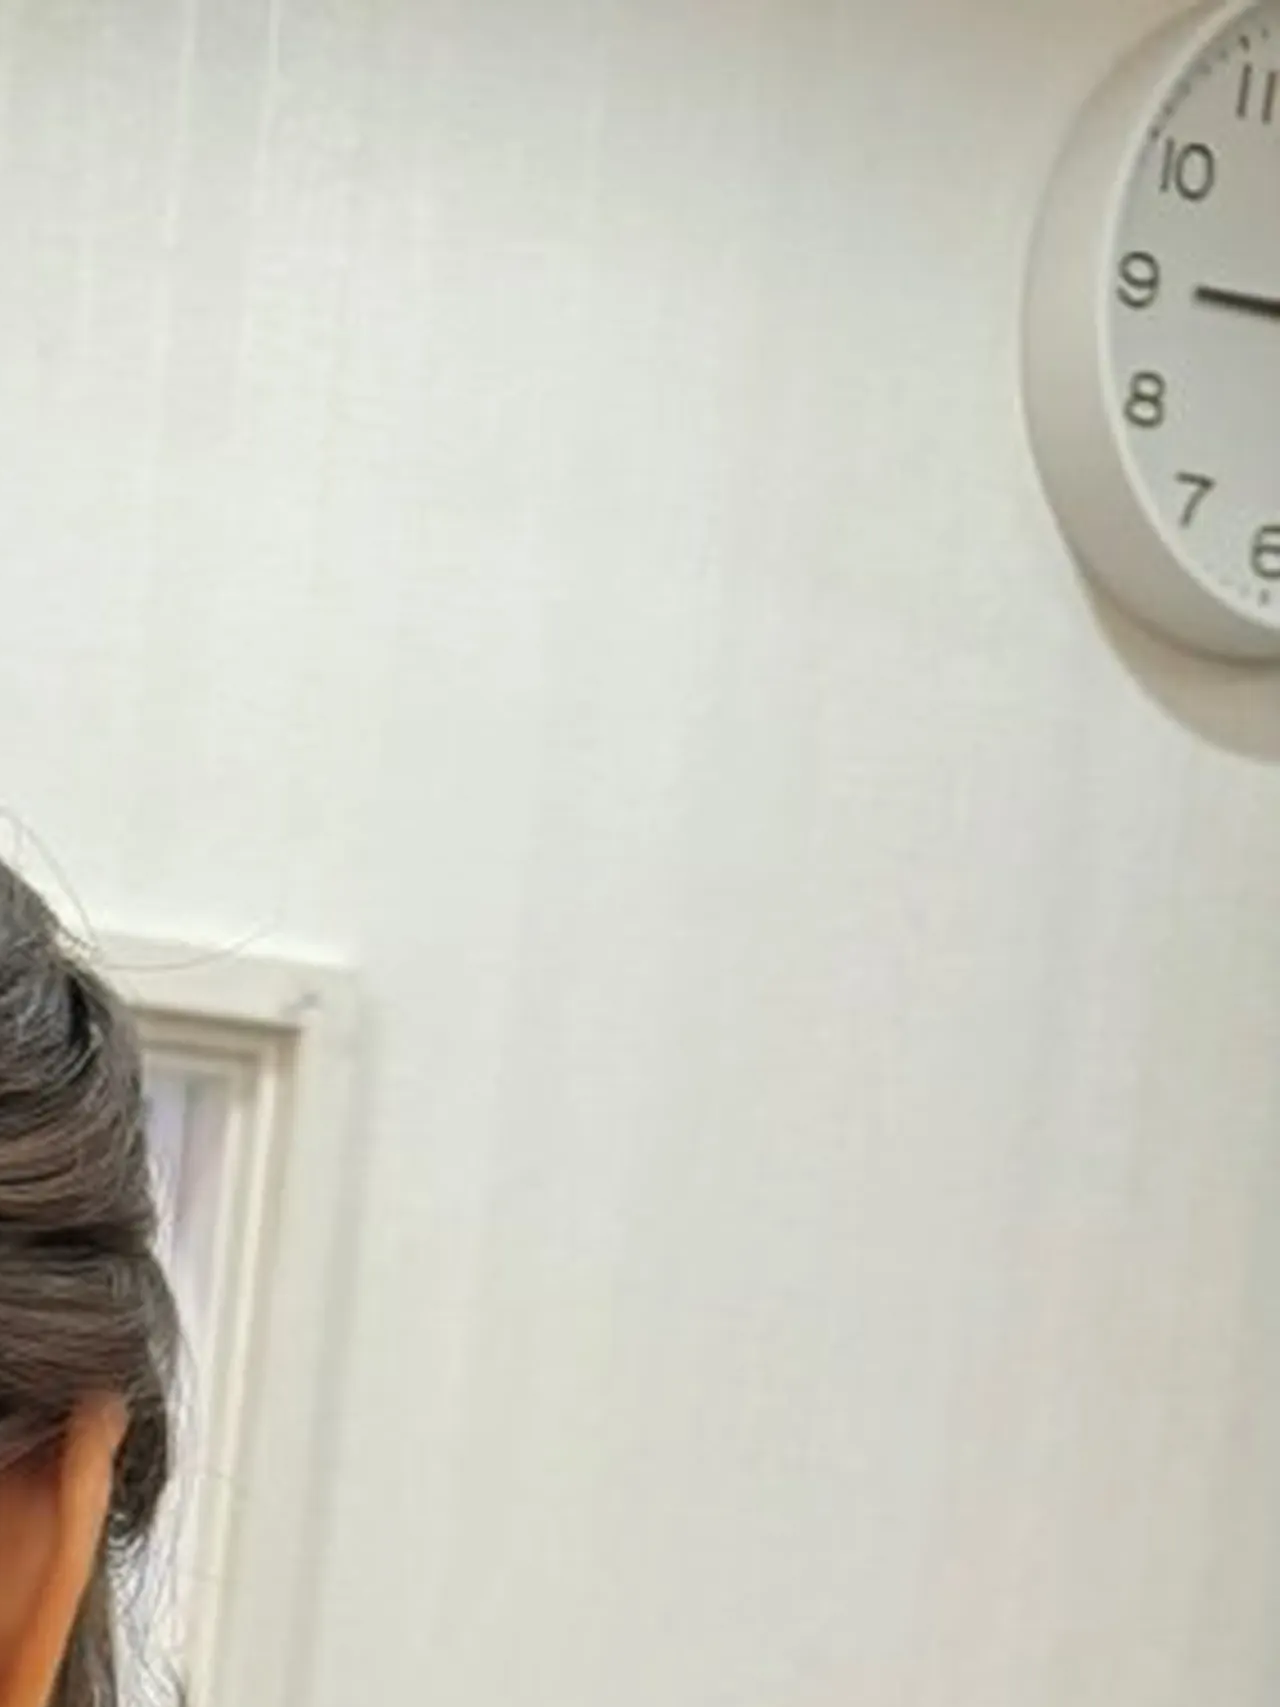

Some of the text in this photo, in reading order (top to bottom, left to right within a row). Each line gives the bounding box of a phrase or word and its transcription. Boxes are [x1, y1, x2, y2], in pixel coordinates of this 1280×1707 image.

[1159, 137, 1214, 202] 10
[1116, 250, 1161, 310] 9
[1123, 371, 1167, 428] 8
[1174, 472, 1215, 529] 7
